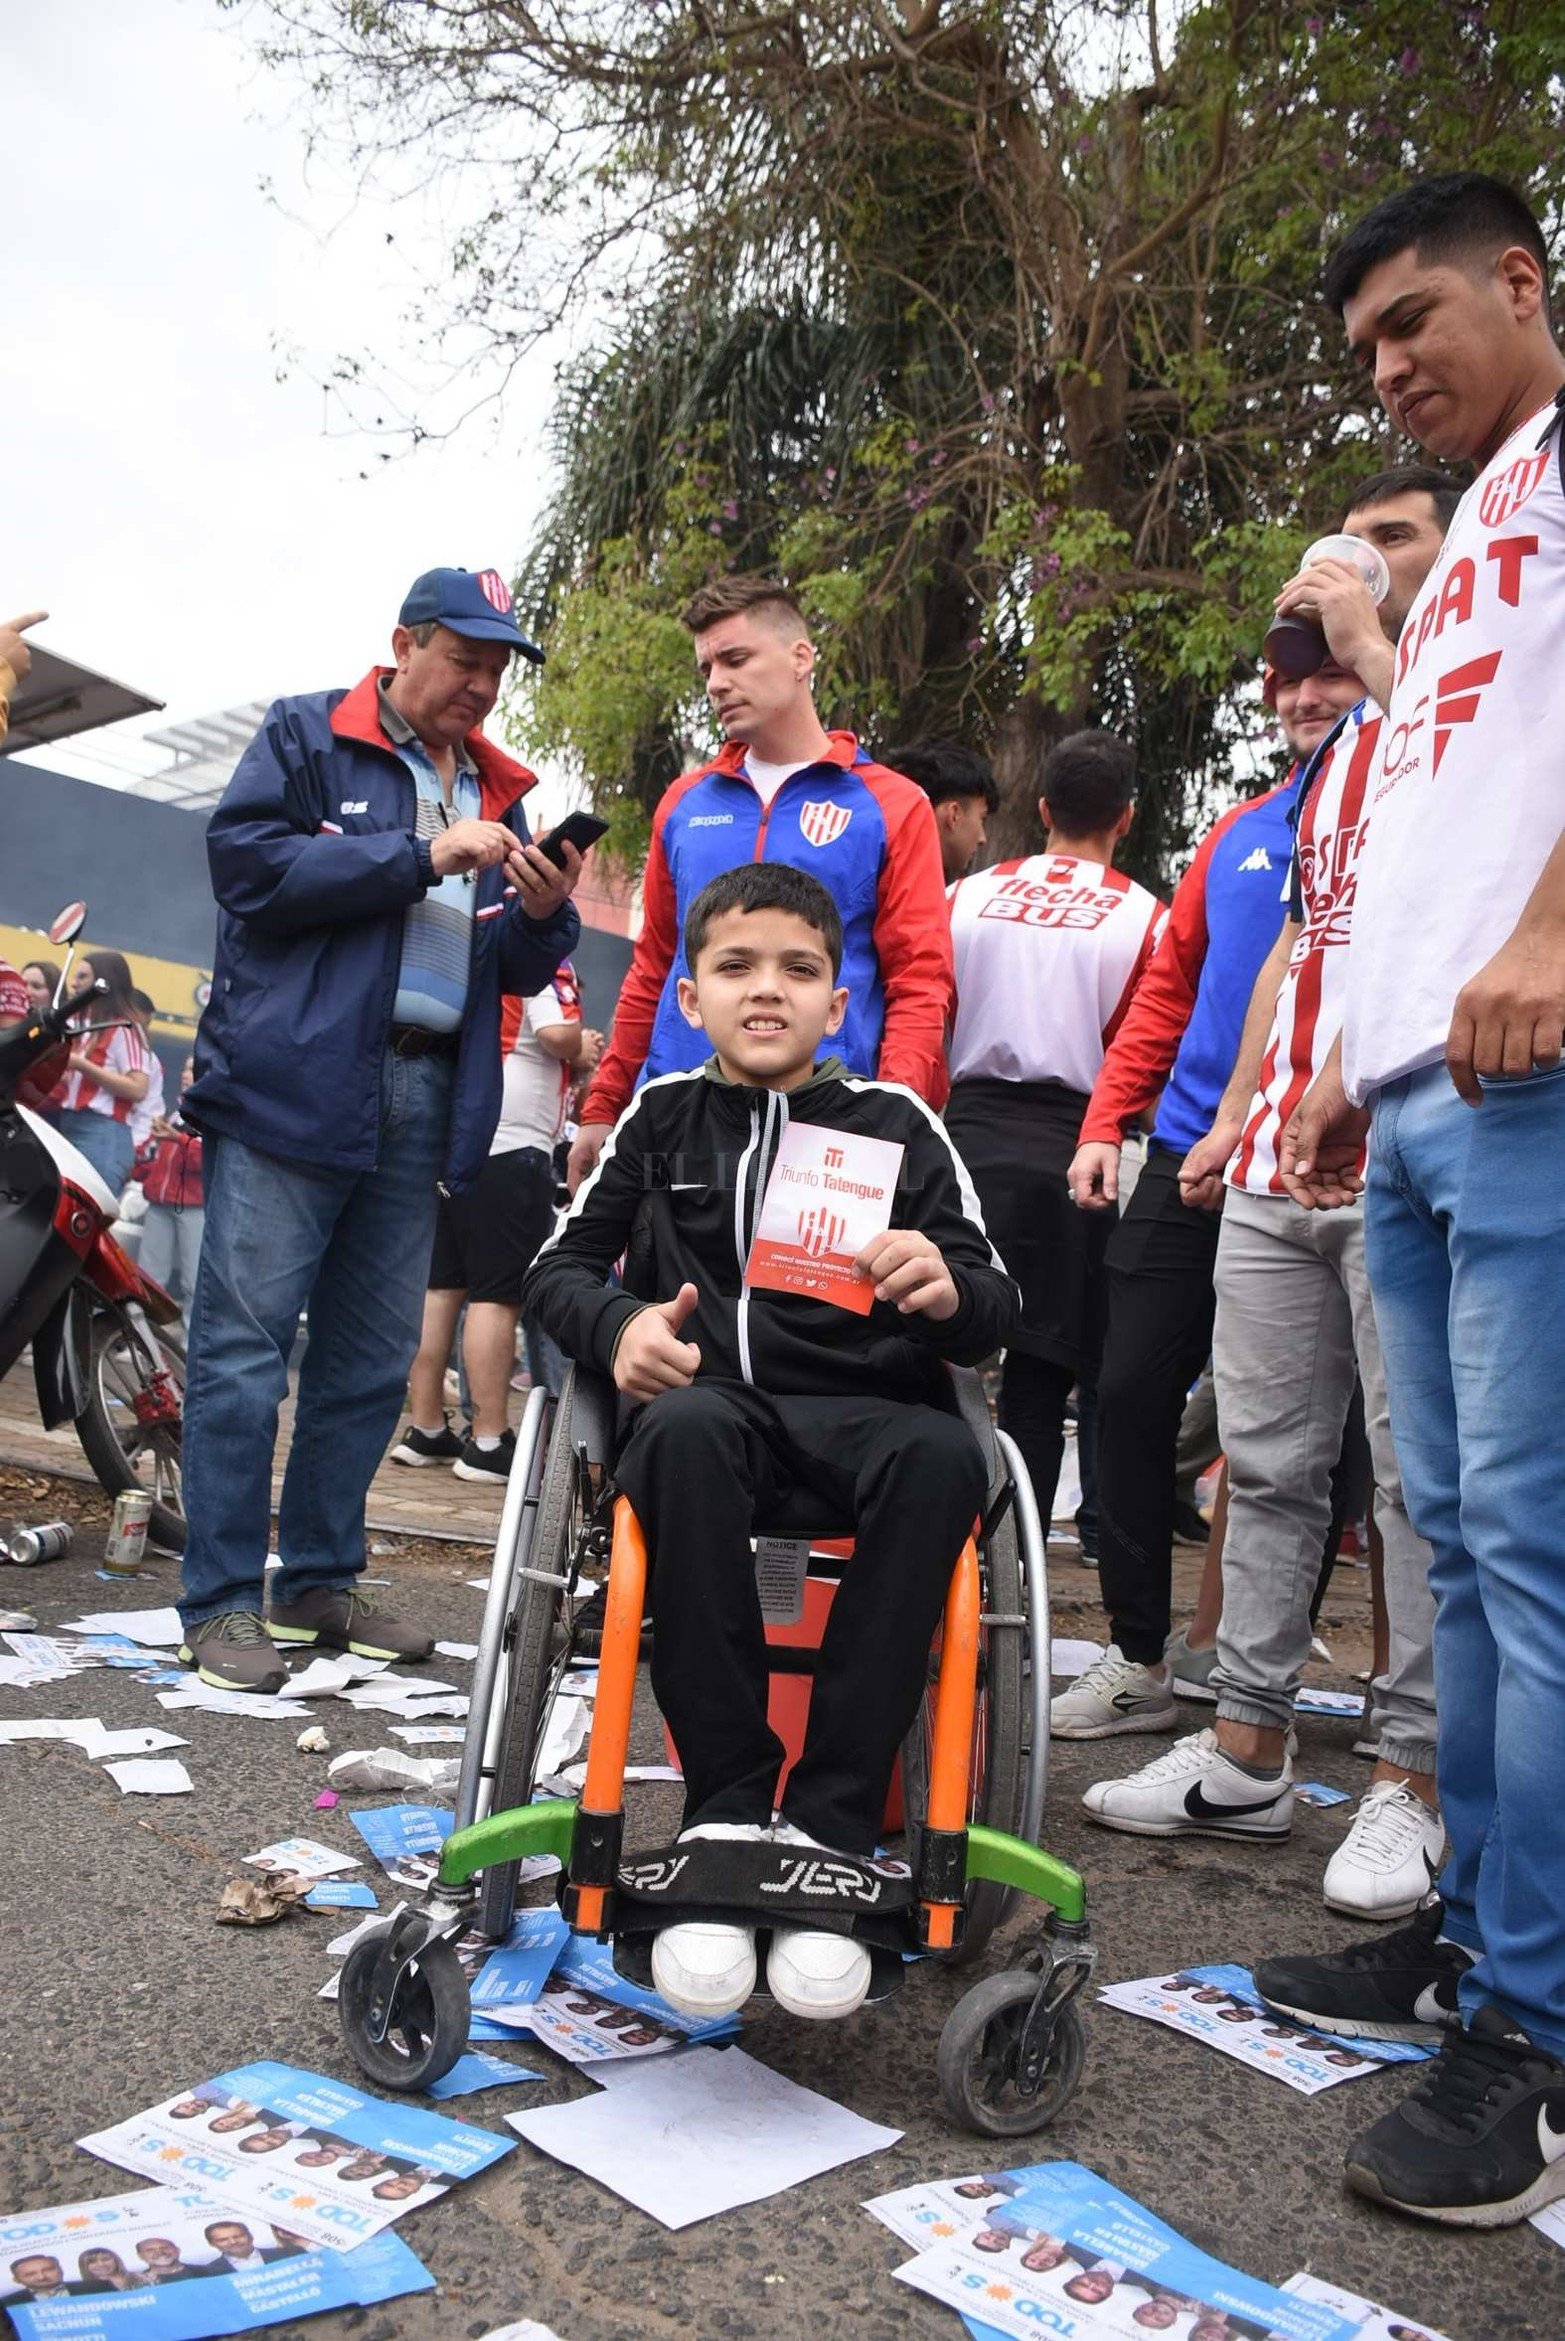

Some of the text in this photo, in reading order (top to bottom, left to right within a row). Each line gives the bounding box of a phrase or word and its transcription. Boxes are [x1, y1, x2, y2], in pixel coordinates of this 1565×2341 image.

[998, 878, 1123, 910] flecha
[979, 899, 1107, 930] BUS
[780, 1164, 819, 1188] Triunfo
[822, 1172, 885, 1200] Tatengue
[766, 1541, 798, 1550] NOTICE
